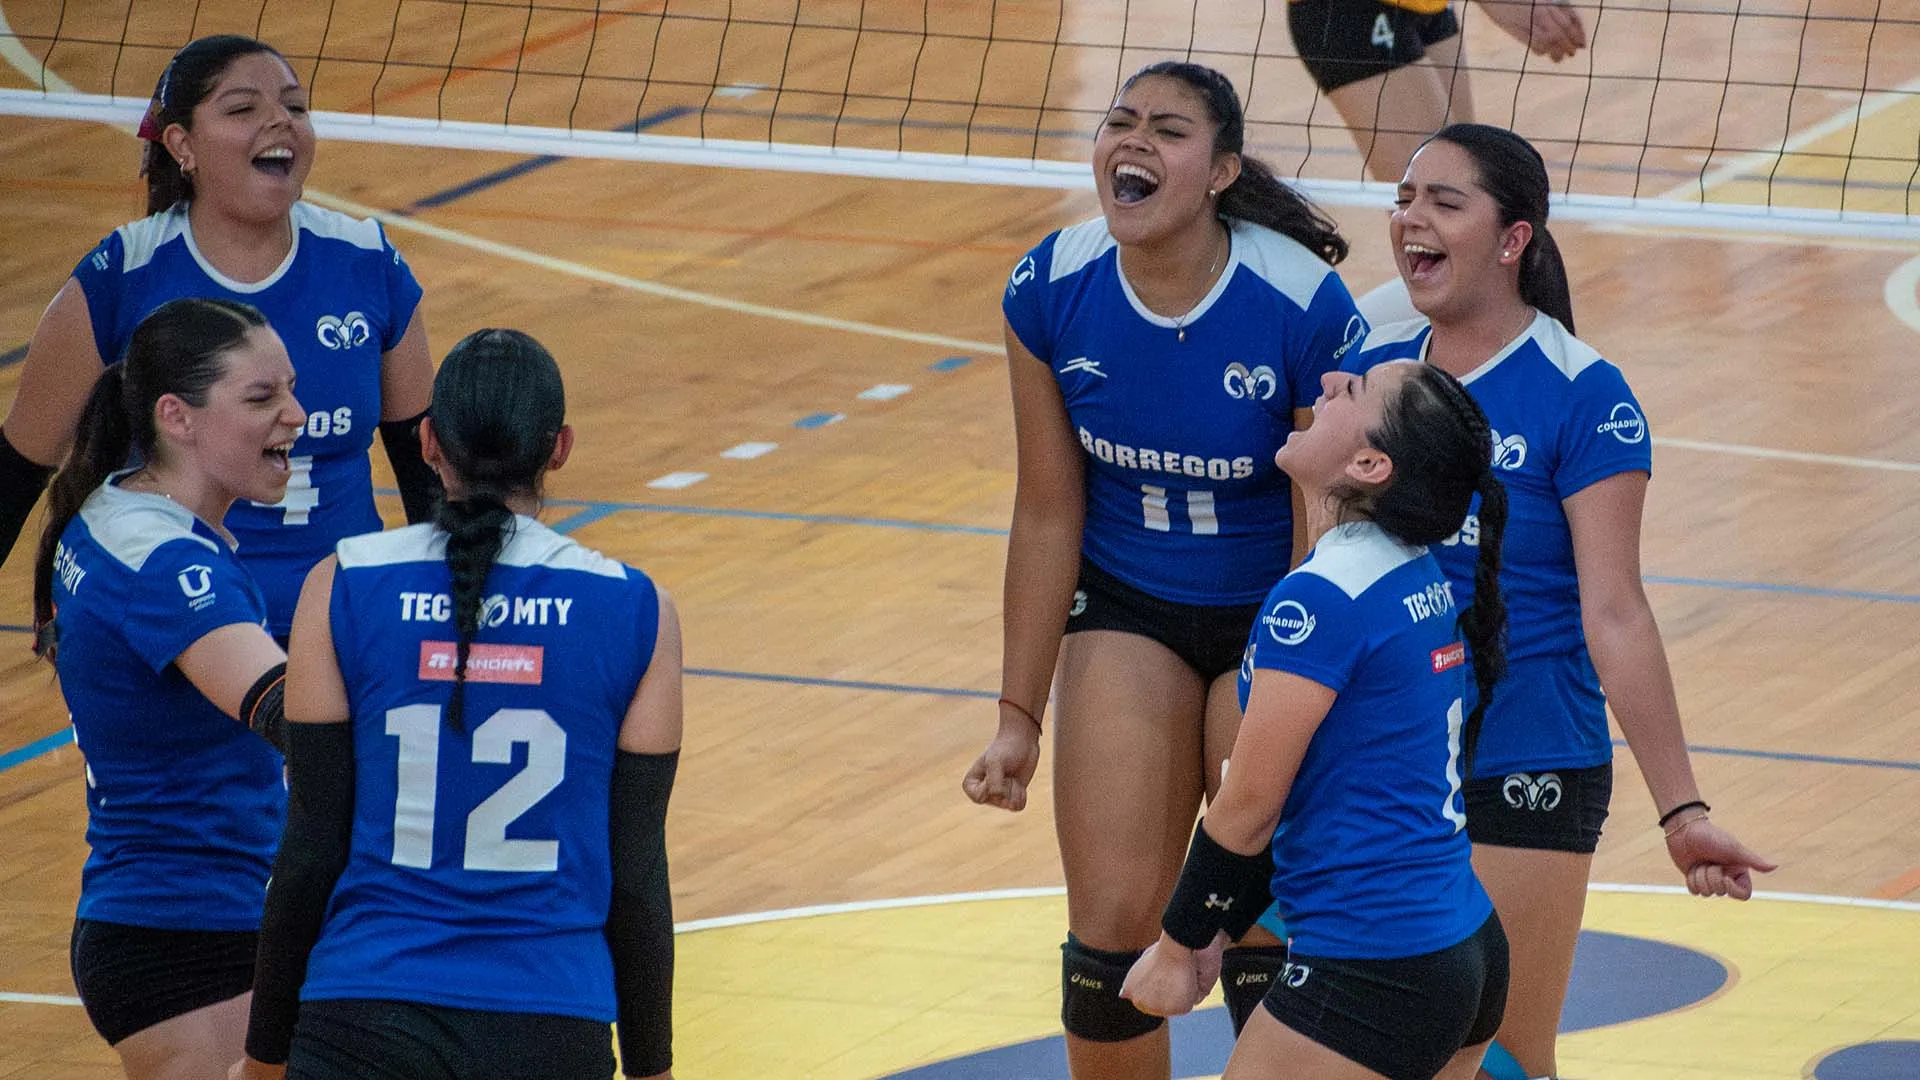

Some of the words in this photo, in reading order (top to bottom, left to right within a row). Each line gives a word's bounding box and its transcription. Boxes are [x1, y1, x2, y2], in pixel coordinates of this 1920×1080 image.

[1372, 13, 1395, 49] 4
[1079, 425, 1254, 481] BORREGOS
[1140, 483, 1219, 536] 11
[399, 591, 451, 623] TEC
[512, 596, 573, 626] MTY
[1403, 591, 1431, 624] TEC
[384, 703, 568, 872] 12
